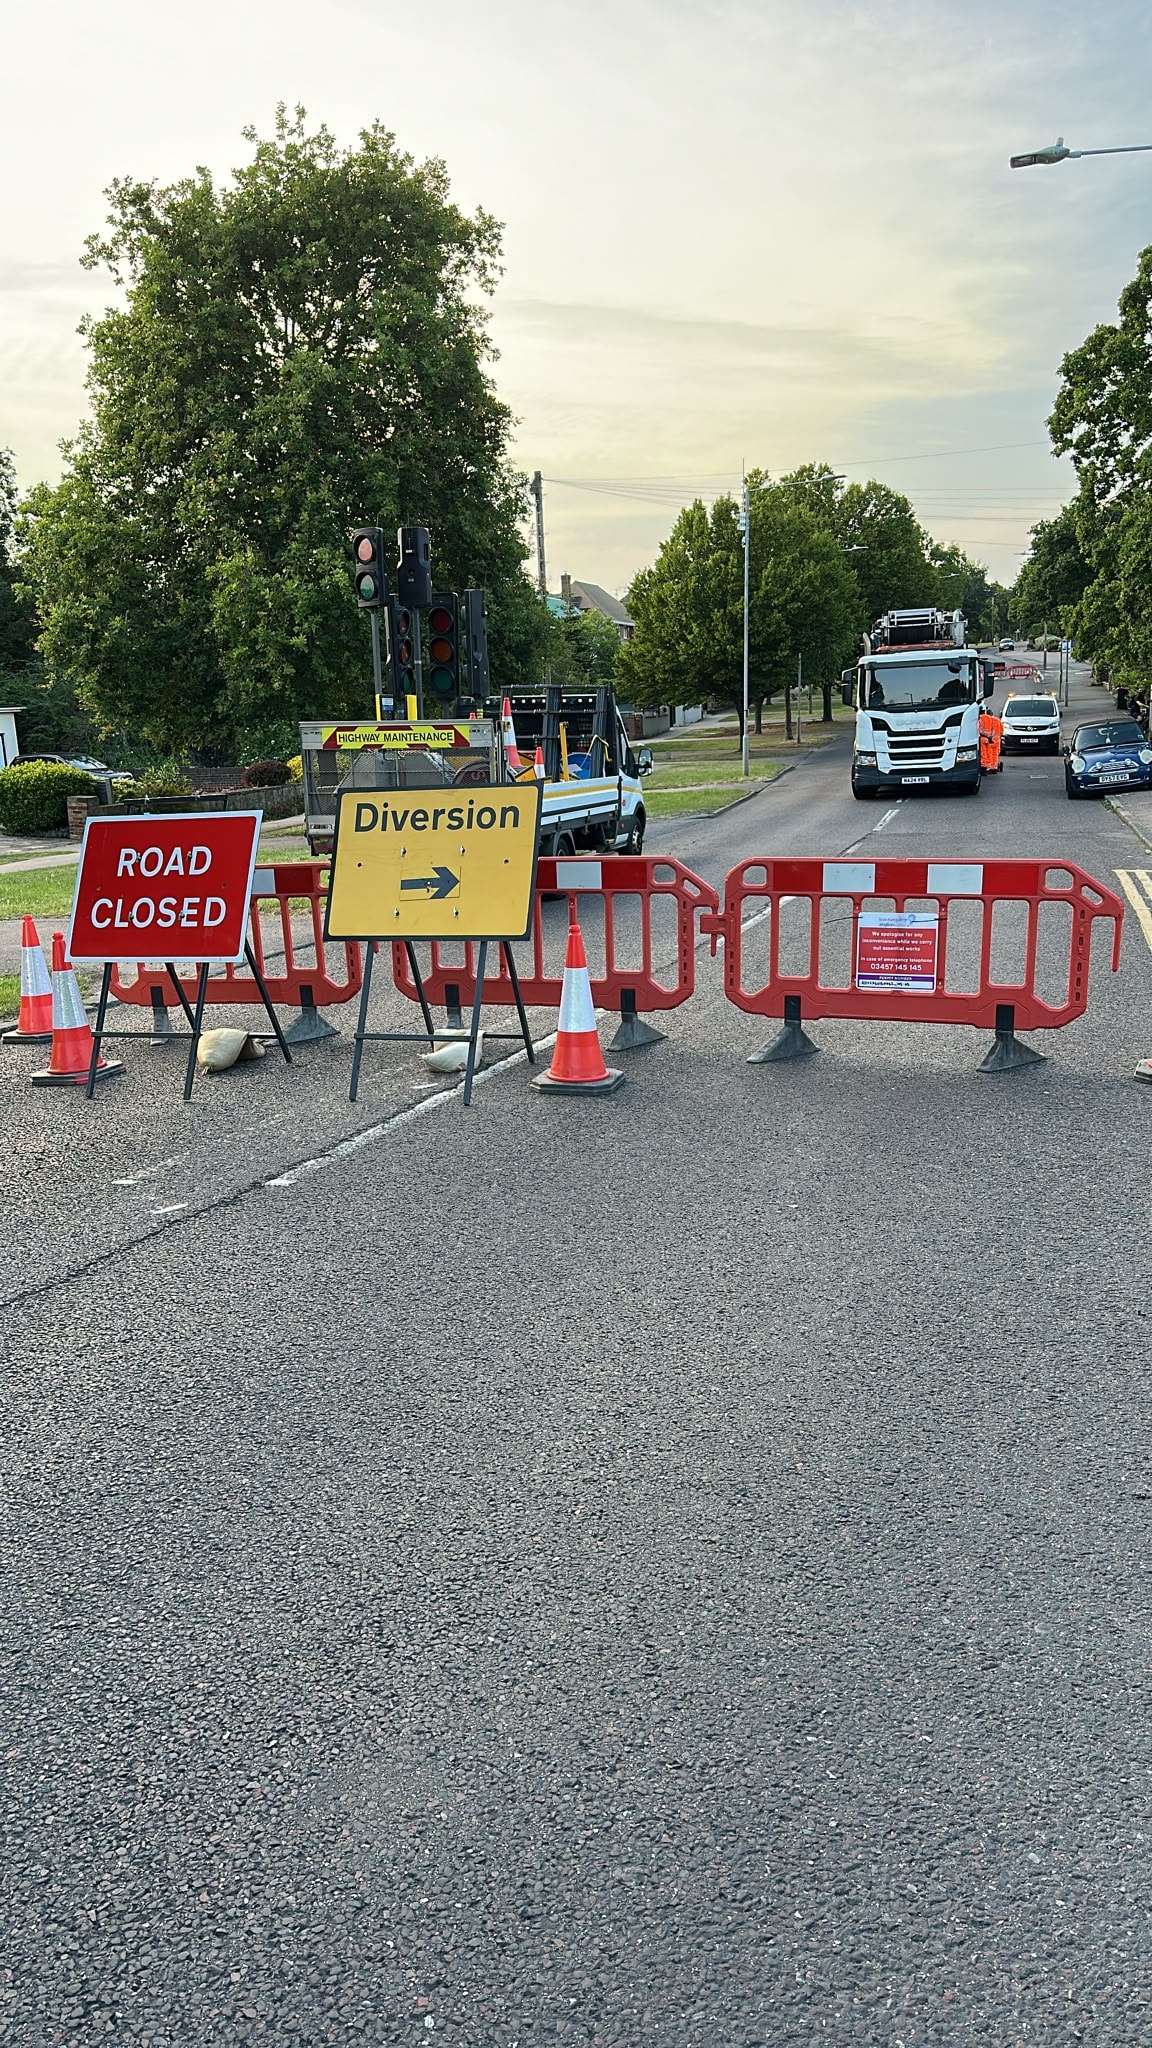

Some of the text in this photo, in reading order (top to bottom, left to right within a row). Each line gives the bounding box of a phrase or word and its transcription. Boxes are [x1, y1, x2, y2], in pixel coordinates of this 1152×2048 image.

[338, 732, 453, 743] HIGHWAY MAINTENANCE
[354, 799, 519, 833] Diversion
[116, 846, 212, 877] ROAD
[90, 896, 227, 929] CLOSED
